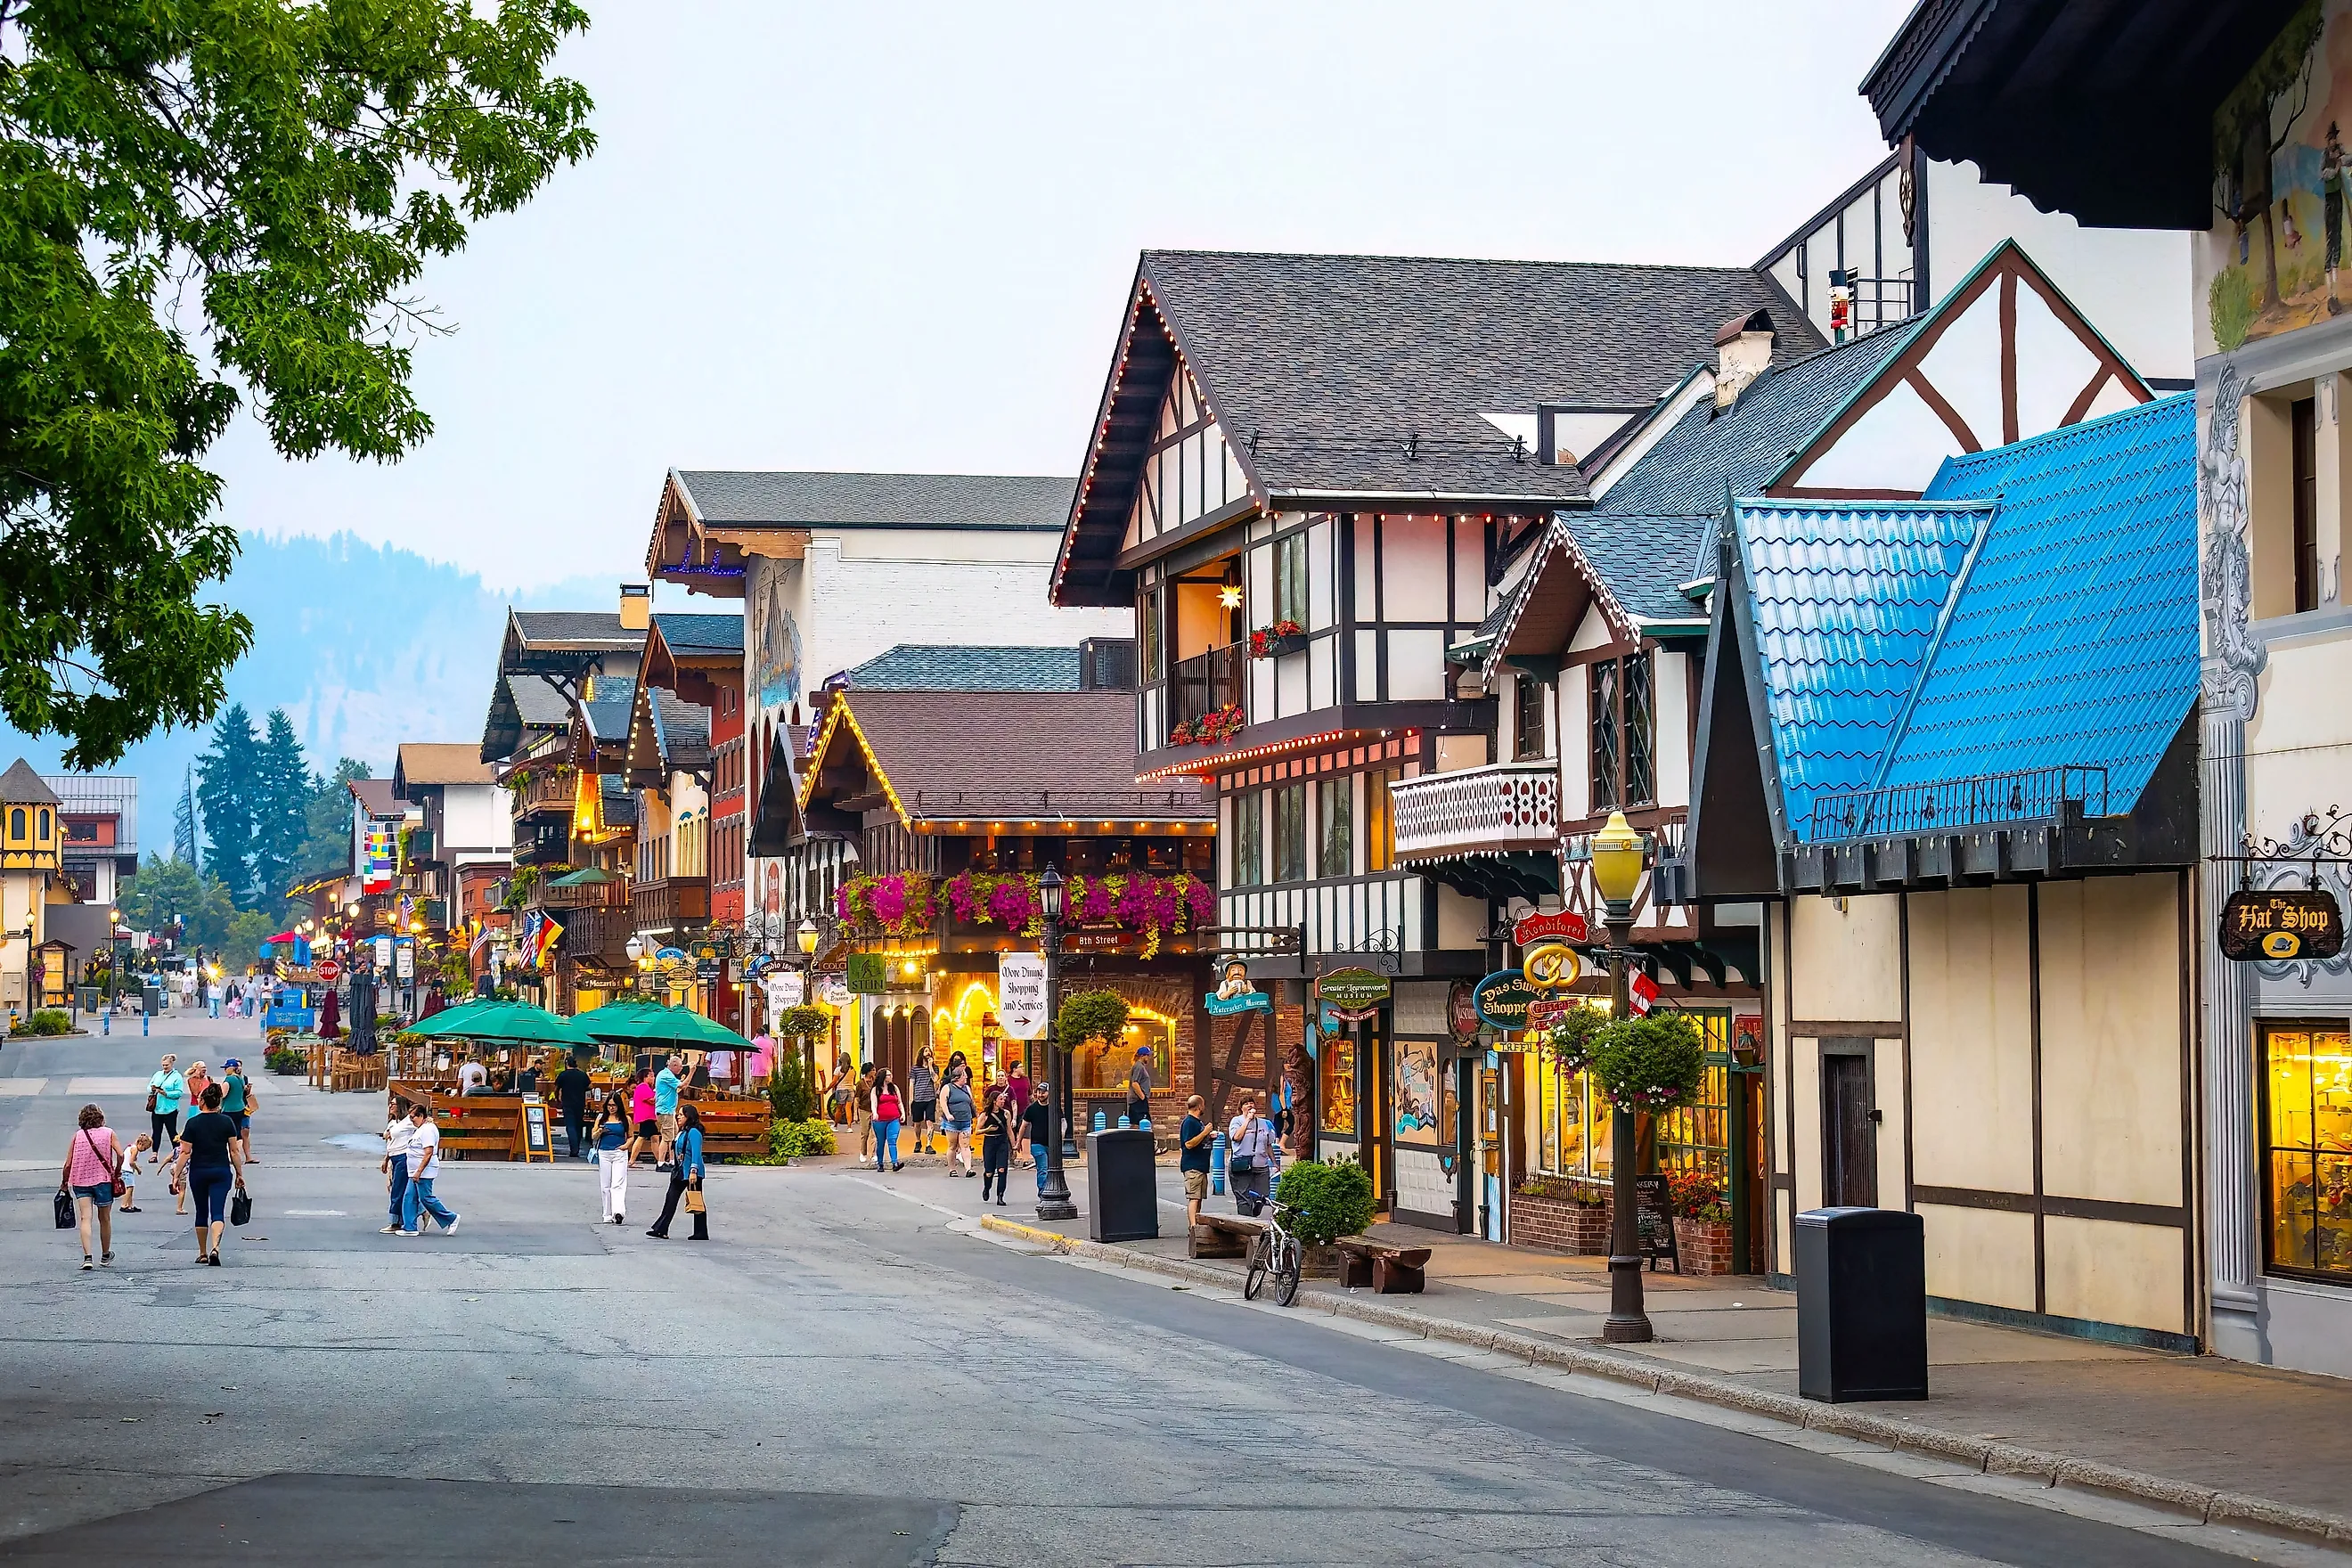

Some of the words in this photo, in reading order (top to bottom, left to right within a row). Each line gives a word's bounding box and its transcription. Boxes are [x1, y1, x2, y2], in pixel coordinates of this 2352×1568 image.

[2269, 898, 2287, 911] The
[2238, 904, 2272, 932] Hat
[2281, 905, 2329, 932] Shop
[1520, 917, 1582, 940] Konditorei
[1079, 936, 1092, 945] 8th
[1095, 935, 1118, 944] Street
[319, 966, 339, 976] STOP
[760, 961, 780, 975] Studio
[1001, 966, 1020, 977] More
[770, 983, 784, 992] More
[852, 979, 884, 990] STEIN
[1008, 981, 1040, 997] Shopping
[1319, 984, 1346, 993] Greater
[1346, 983, 1388, 993] Leavenworth
[1481, 983, 1510, 1001] Das
[774, 994, 799, 1006] Shopping
[1003, 1000, 1017, 1011] and
[1017, 999, 1043, 1011] Services
[1482, 1000, 1527, 1016] Shoppe
[1499, 1042, 1532, 1052] TAFFY
